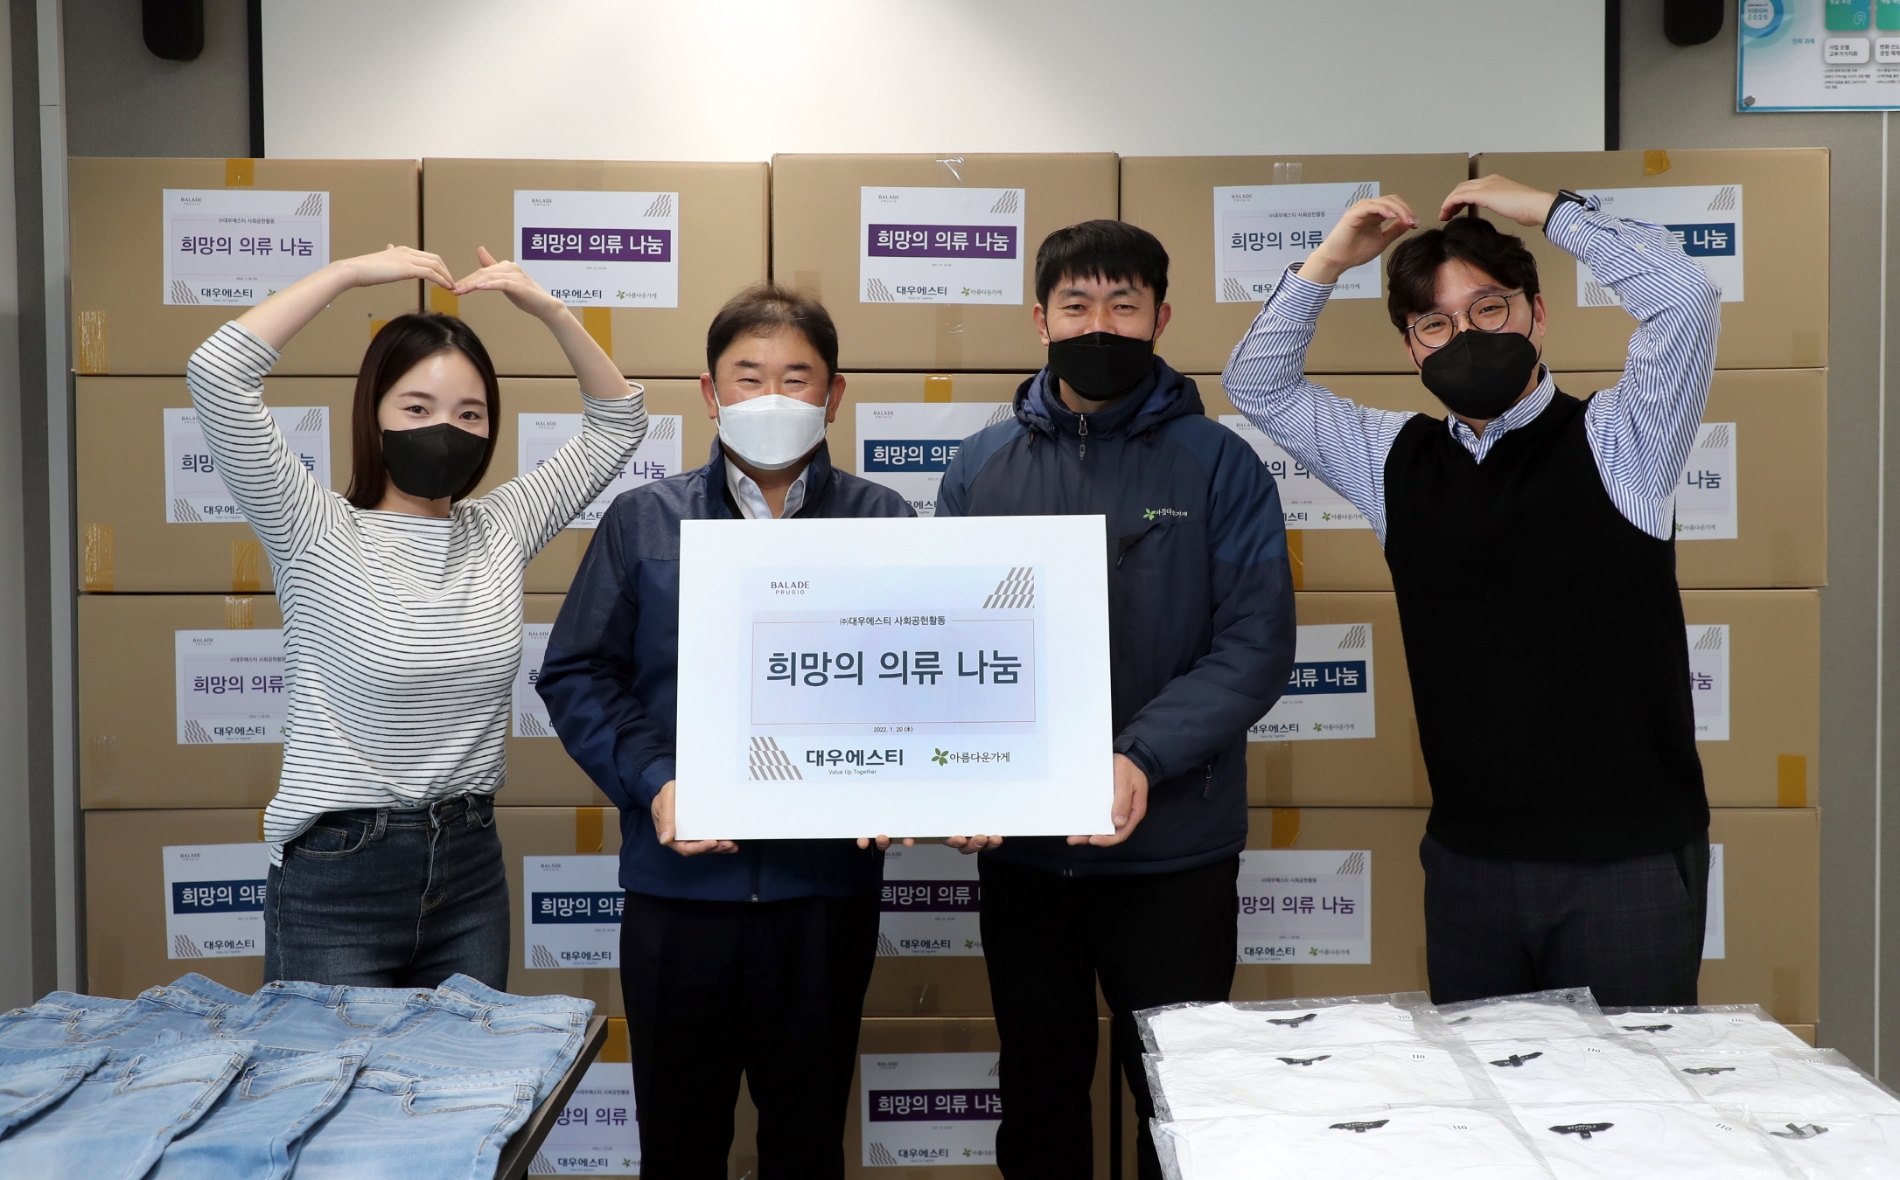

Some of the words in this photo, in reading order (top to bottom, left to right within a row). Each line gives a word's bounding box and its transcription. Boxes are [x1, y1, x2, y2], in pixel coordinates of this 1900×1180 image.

[181, 236, 232, 255] 희망의
[239, 237, 273, 256] 의류
[280, 238, 314, 256] 나눔
[531, 233, 582, 254] 희망의
[589, 234, 623, 254] 의류
[630, 235, 663, 255] 나눔
[877, 230, 928, 250] 희망의
[935, 231, 969, 251] 의류
[975, 232, 1010, 251] 나눔
[1231, 231, 1282, 251] 희망의
[1290, 230, 1324, 250] 의류
[1693, 229, 1728, 249] 나눔
[201, 288, 253, 298] 대우에스티
[551, 289, 602, 299] 대우에스티
[896, 285, 948, 296] 대우에스티
[181, 454, 214, 473] 희망
[300, 453, 316, 471] 눔
[873, 446, 924, 465] 희망의
[633, 461, 667, 479] 나눔
[1687, 470, 1721, 489] 나눔
[204, 505, 243, 515] 대우에스
[771, 581, 810, 589] BALADE
[894, 615, 946, 626] 사회공헌활동
[766, 650, 864, 686] 희망의
[878, 650, 944, 686] 의류
[957, 649, 1022, 685] 나눔
[1325, 667, 1359, 686] 나눔
[193, 676, 243, 694] 희망의
[251, 675, 285, 694] 의류
[214, 726, 265, 736] 대우에스티
[806, 749, 904, 767] 대우에스티
[950, 751, 1011, 764] 아름다운가게
[182, 886, 232, 907] 희망의
[881, 886, 930, 905] 희망의
[938, 886, 971, 905] 의류
[541, 897, 591, 916] 희망의
[1237, 896, 1275, 915] 망의
[1282, 896, 1315, 914] 의류
[1322, 896, 1355, 914] 나눔
[204, 940, 255, 950] 대우에스티
[901, 939, 950, 949] 대우에스티
[1244, 947, 1295, 956] 대우에스티
[561, 951, 611, 960] 대우에스티
[878, 1095, 928, 1115] 희망의
[935, 1095, 968, 1114] 의류
[557, 1108, 588, 1126] 망의
[595, 1108, 628, 1126] 의류
[1715, 1123, 1732, 1131] 110
[558, 1158, 608, 1167] 대우에스티
[898, 1149, 949, 1158] 대우에스티
